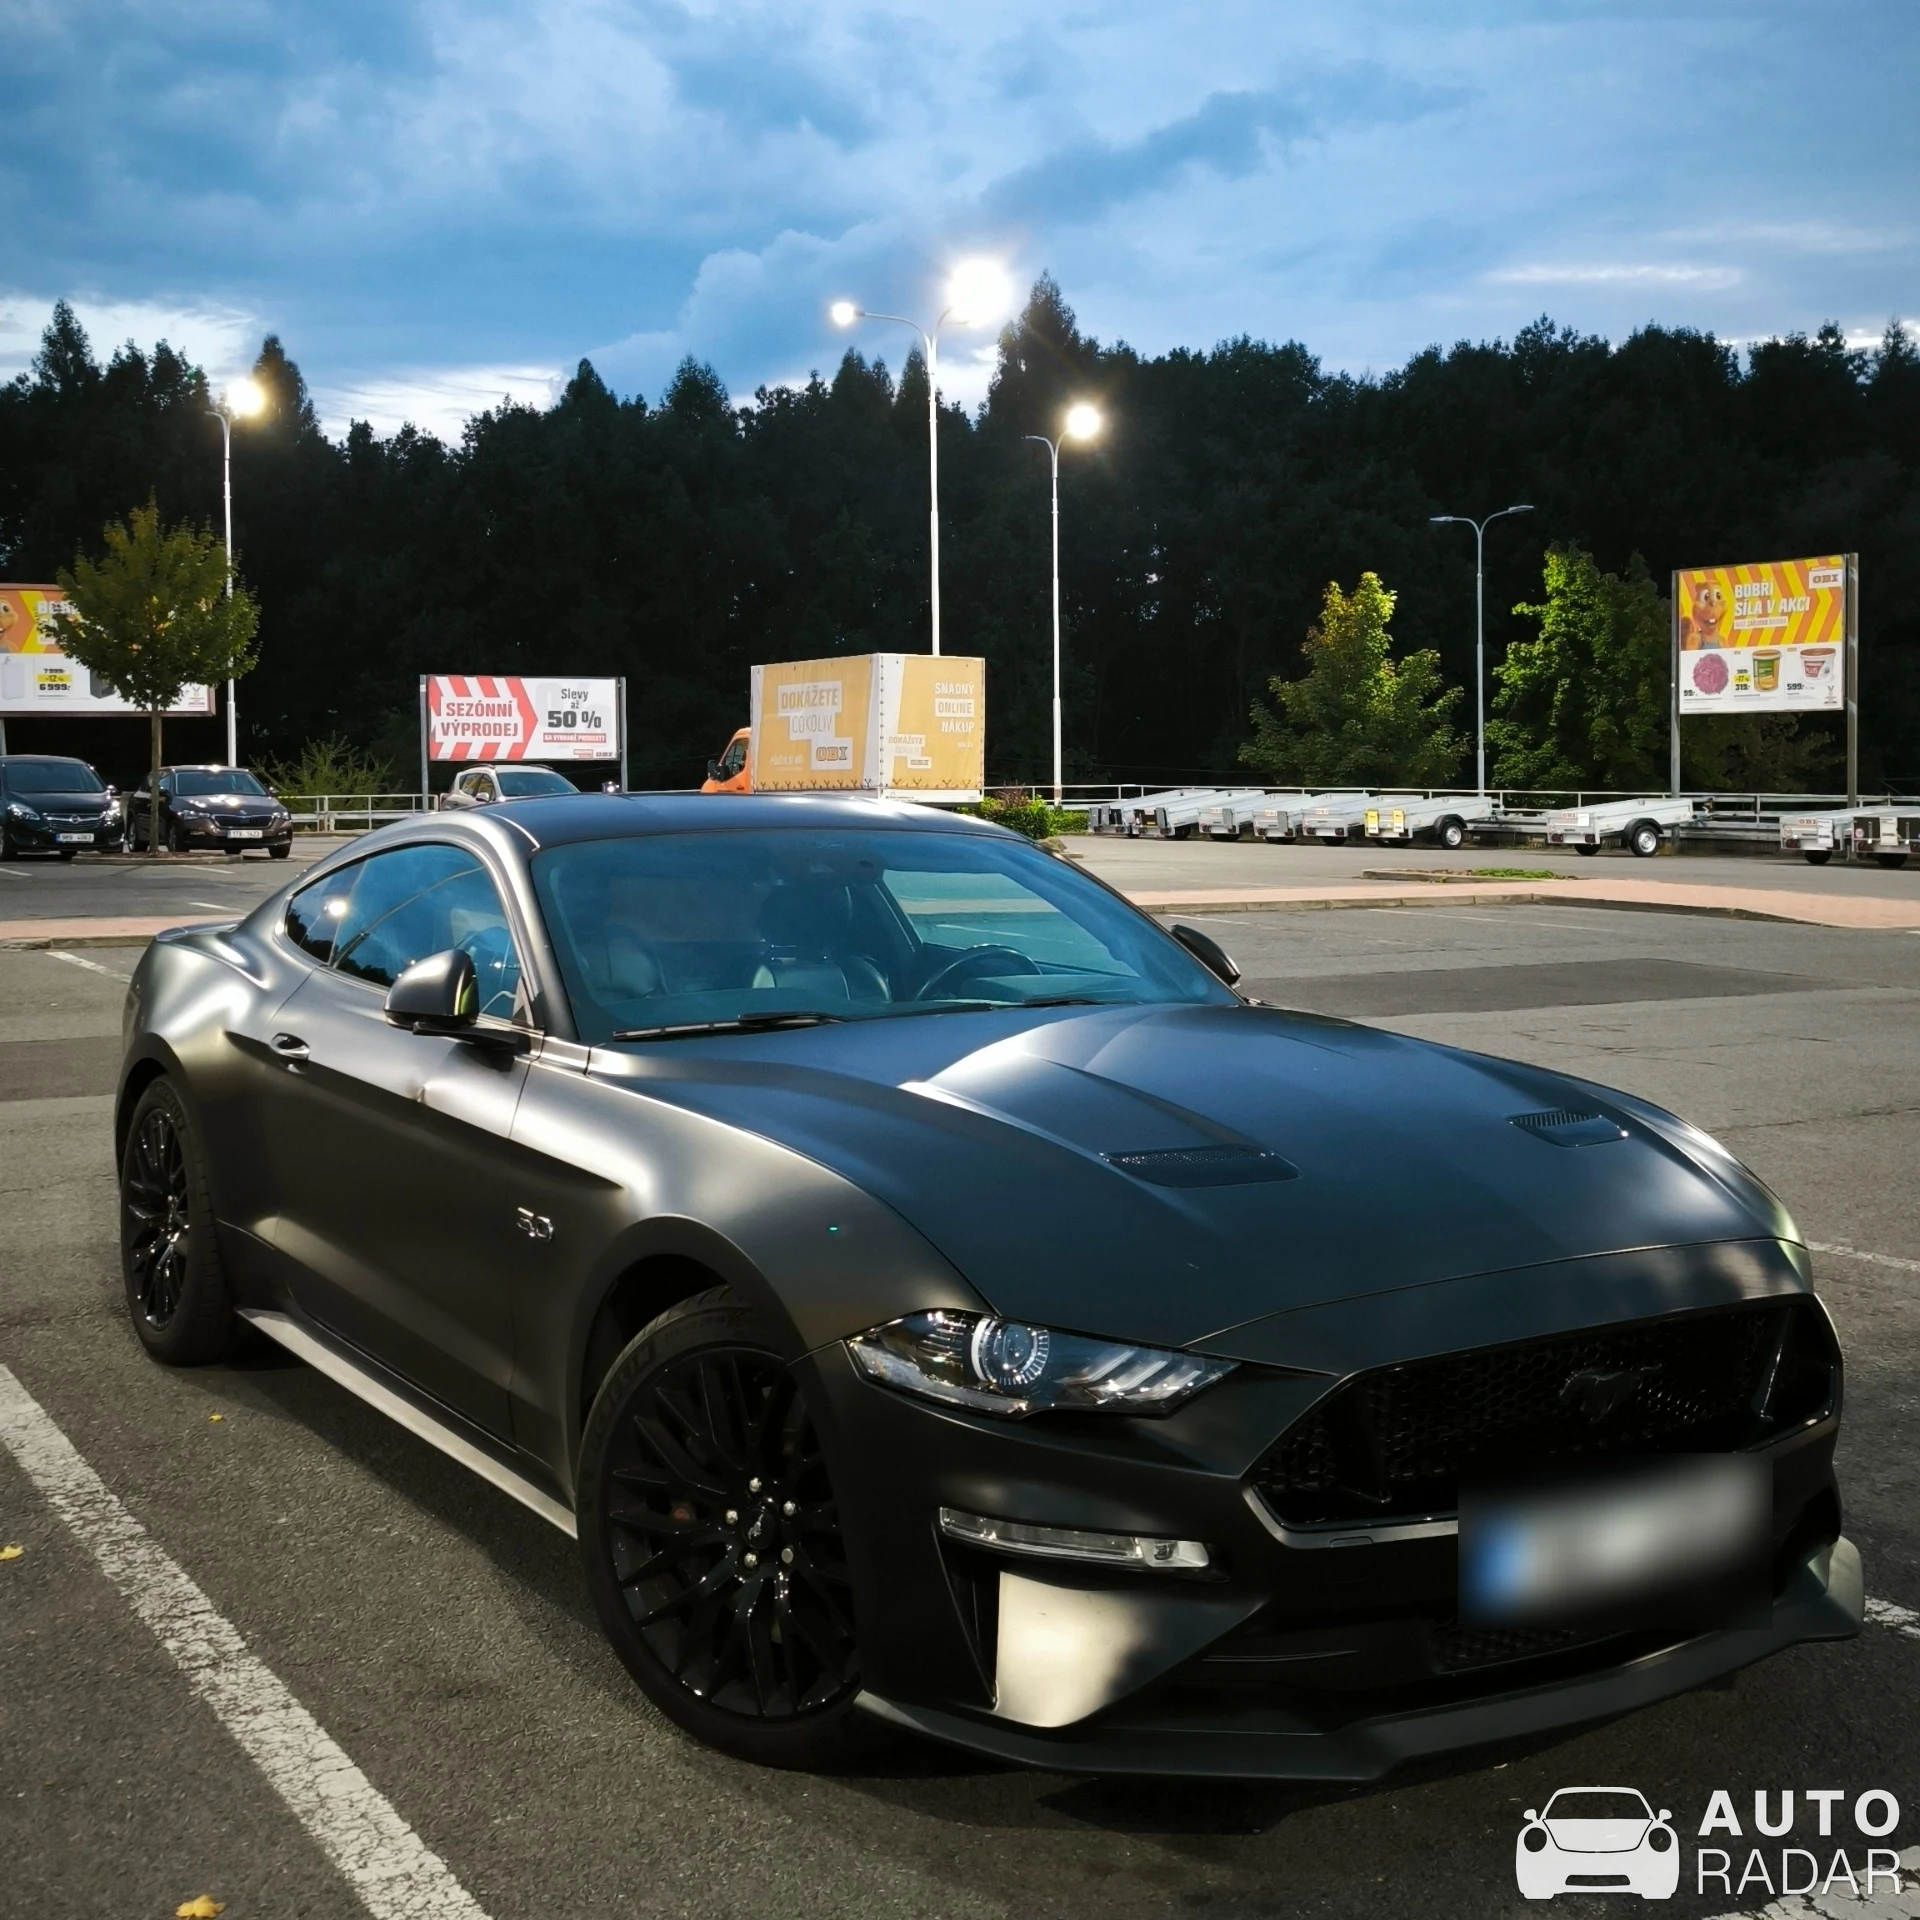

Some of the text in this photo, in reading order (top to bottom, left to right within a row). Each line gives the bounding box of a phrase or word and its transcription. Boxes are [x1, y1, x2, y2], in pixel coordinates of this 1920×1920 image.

[1813, 574, 1838, 584] OBI
[1734, 579, 1774, 598] BOBŘÍ
[1734, 596, 1811, 616] SÍLA V AKCI
[561, 688, 589, 701] Slevy
[935, 681, 975, 695] SNADNÝ
[570, 701, 580, 709] až
[781, 685, 839, 709] DOKÁŽETE
[446, 700, 512, 717] SEZÓNNÍ
[938, 702, 973, 714] ONLINE
[547, 710, 602, 729] 50 %
[792, 714, 833, 733] COKOLIV
[941, 718, 975, 733] NÁKUP
[441, 719, 518, 737] VÝPRODEJ
[816, 746, 848, 761] OBI
